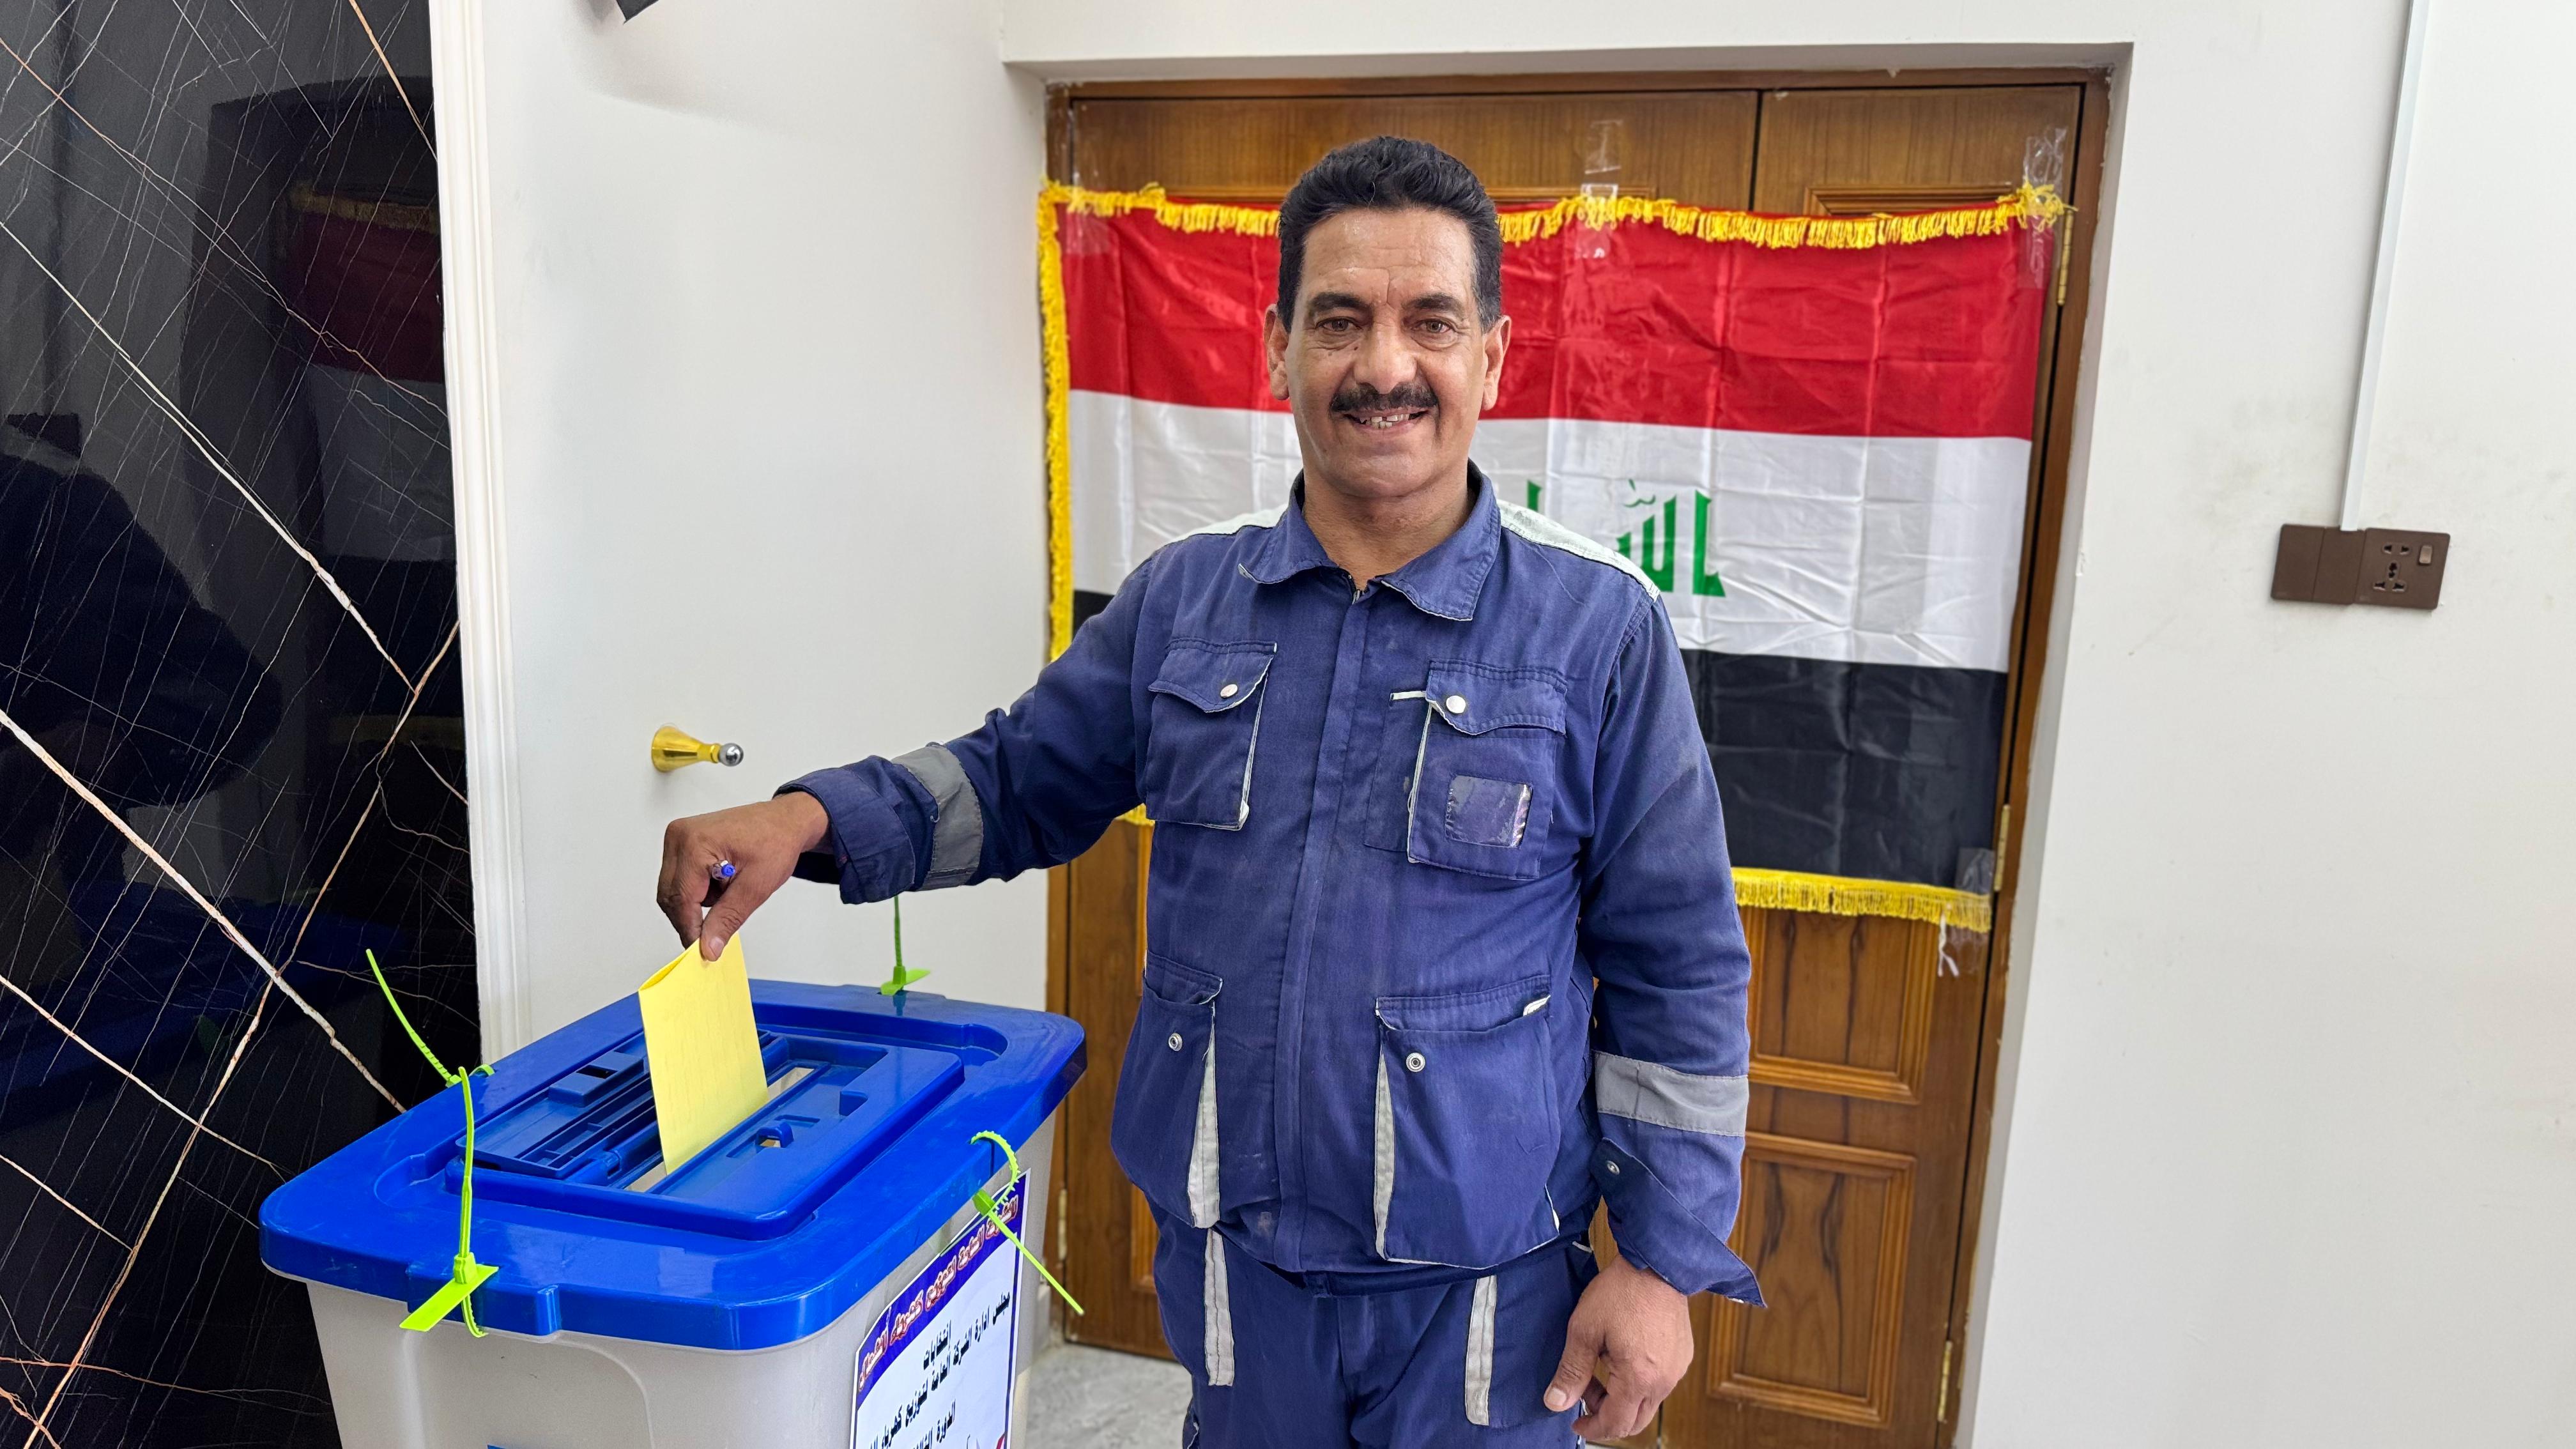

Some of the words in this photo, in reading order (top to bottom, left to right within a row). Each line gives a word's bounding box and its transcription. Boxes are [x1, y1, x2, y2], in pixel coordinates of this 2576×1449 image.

[957, 1223, 985, 1271] العامة
[925, 1255, 957, 1312] لتوزيع
[889, 1289, 923, 1346] كهرباء
[992, 1291, 1011, 1326] مجلس
[859, 1323, 889, 1392] الشمال
[953, 1324, 972, 1365] الشركة
[931, 1351, 951, 1392] العامة
[905, 1377, 928, 1428] لتوزيع
[936, 1399, 956, 1444] الدورة
[881, 1404, 902, 1449] كهرباء
